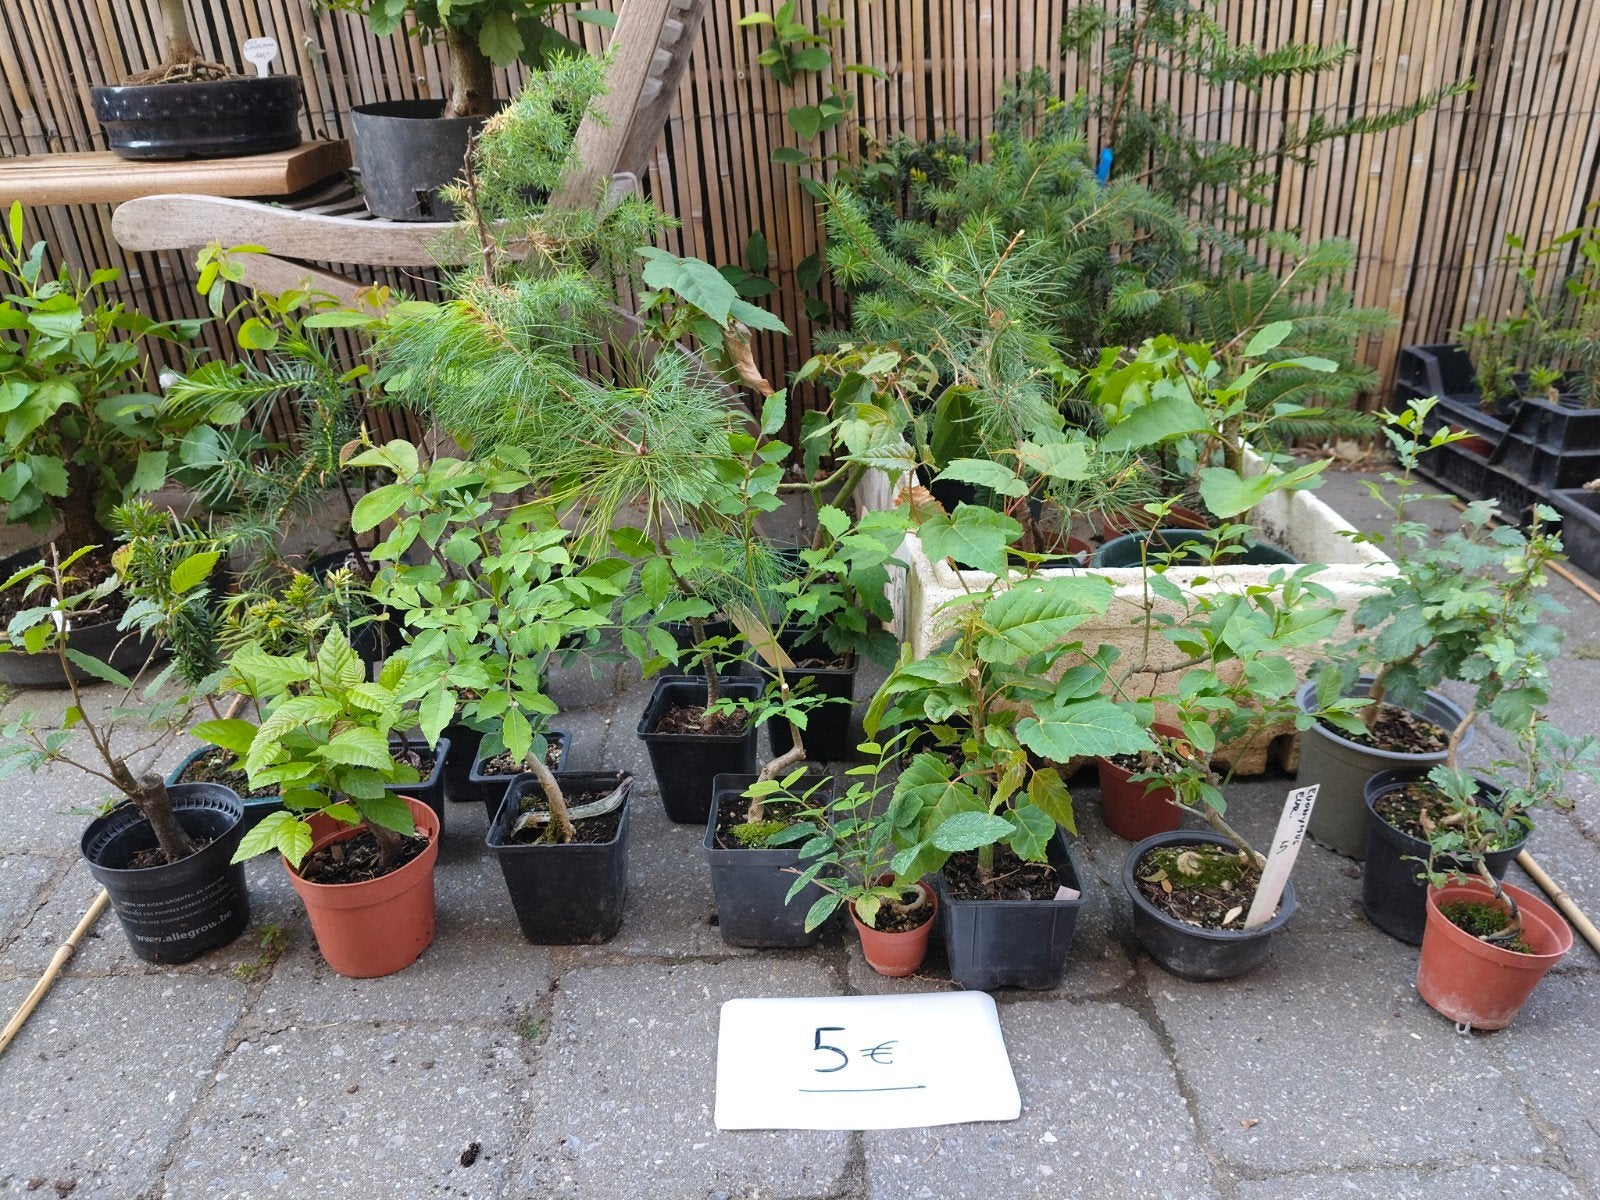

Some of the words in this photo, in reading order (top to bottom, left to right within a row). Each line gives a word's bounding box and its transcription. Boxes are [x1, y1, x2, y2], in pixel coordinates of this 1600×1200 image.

[135, 910, 233, 943] www.allegrow.be
[814, 1027, 848, 1072] 5
[859, 1040, 899, 1064] €
